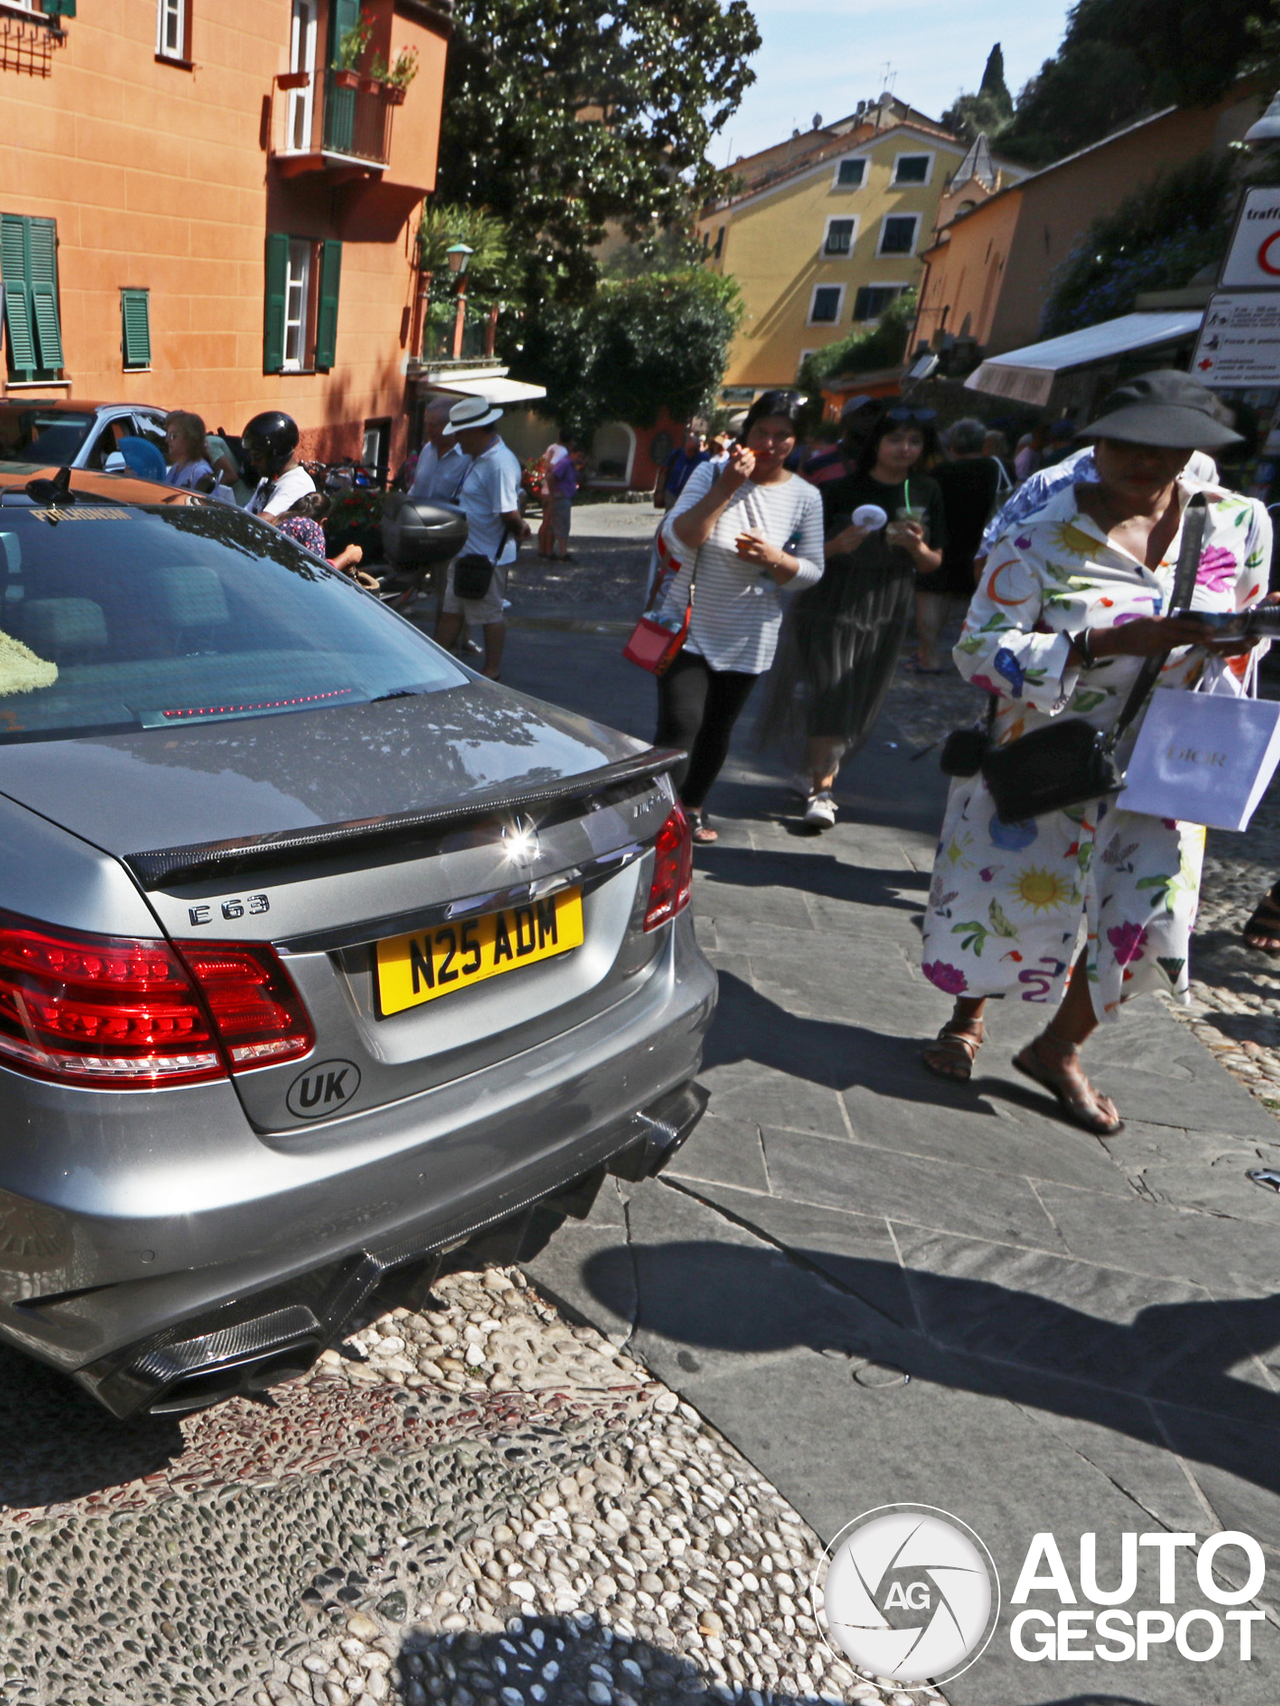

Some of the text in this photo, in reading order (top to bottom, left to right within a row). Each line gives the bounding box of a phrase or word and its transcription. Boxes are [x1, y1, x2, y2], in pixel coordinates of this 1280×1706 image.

[1167, 746, 1227, 767] DIOR
[408, 894, 558, 994] N25 ADM
[299, 1067, 350, 1102] UK
